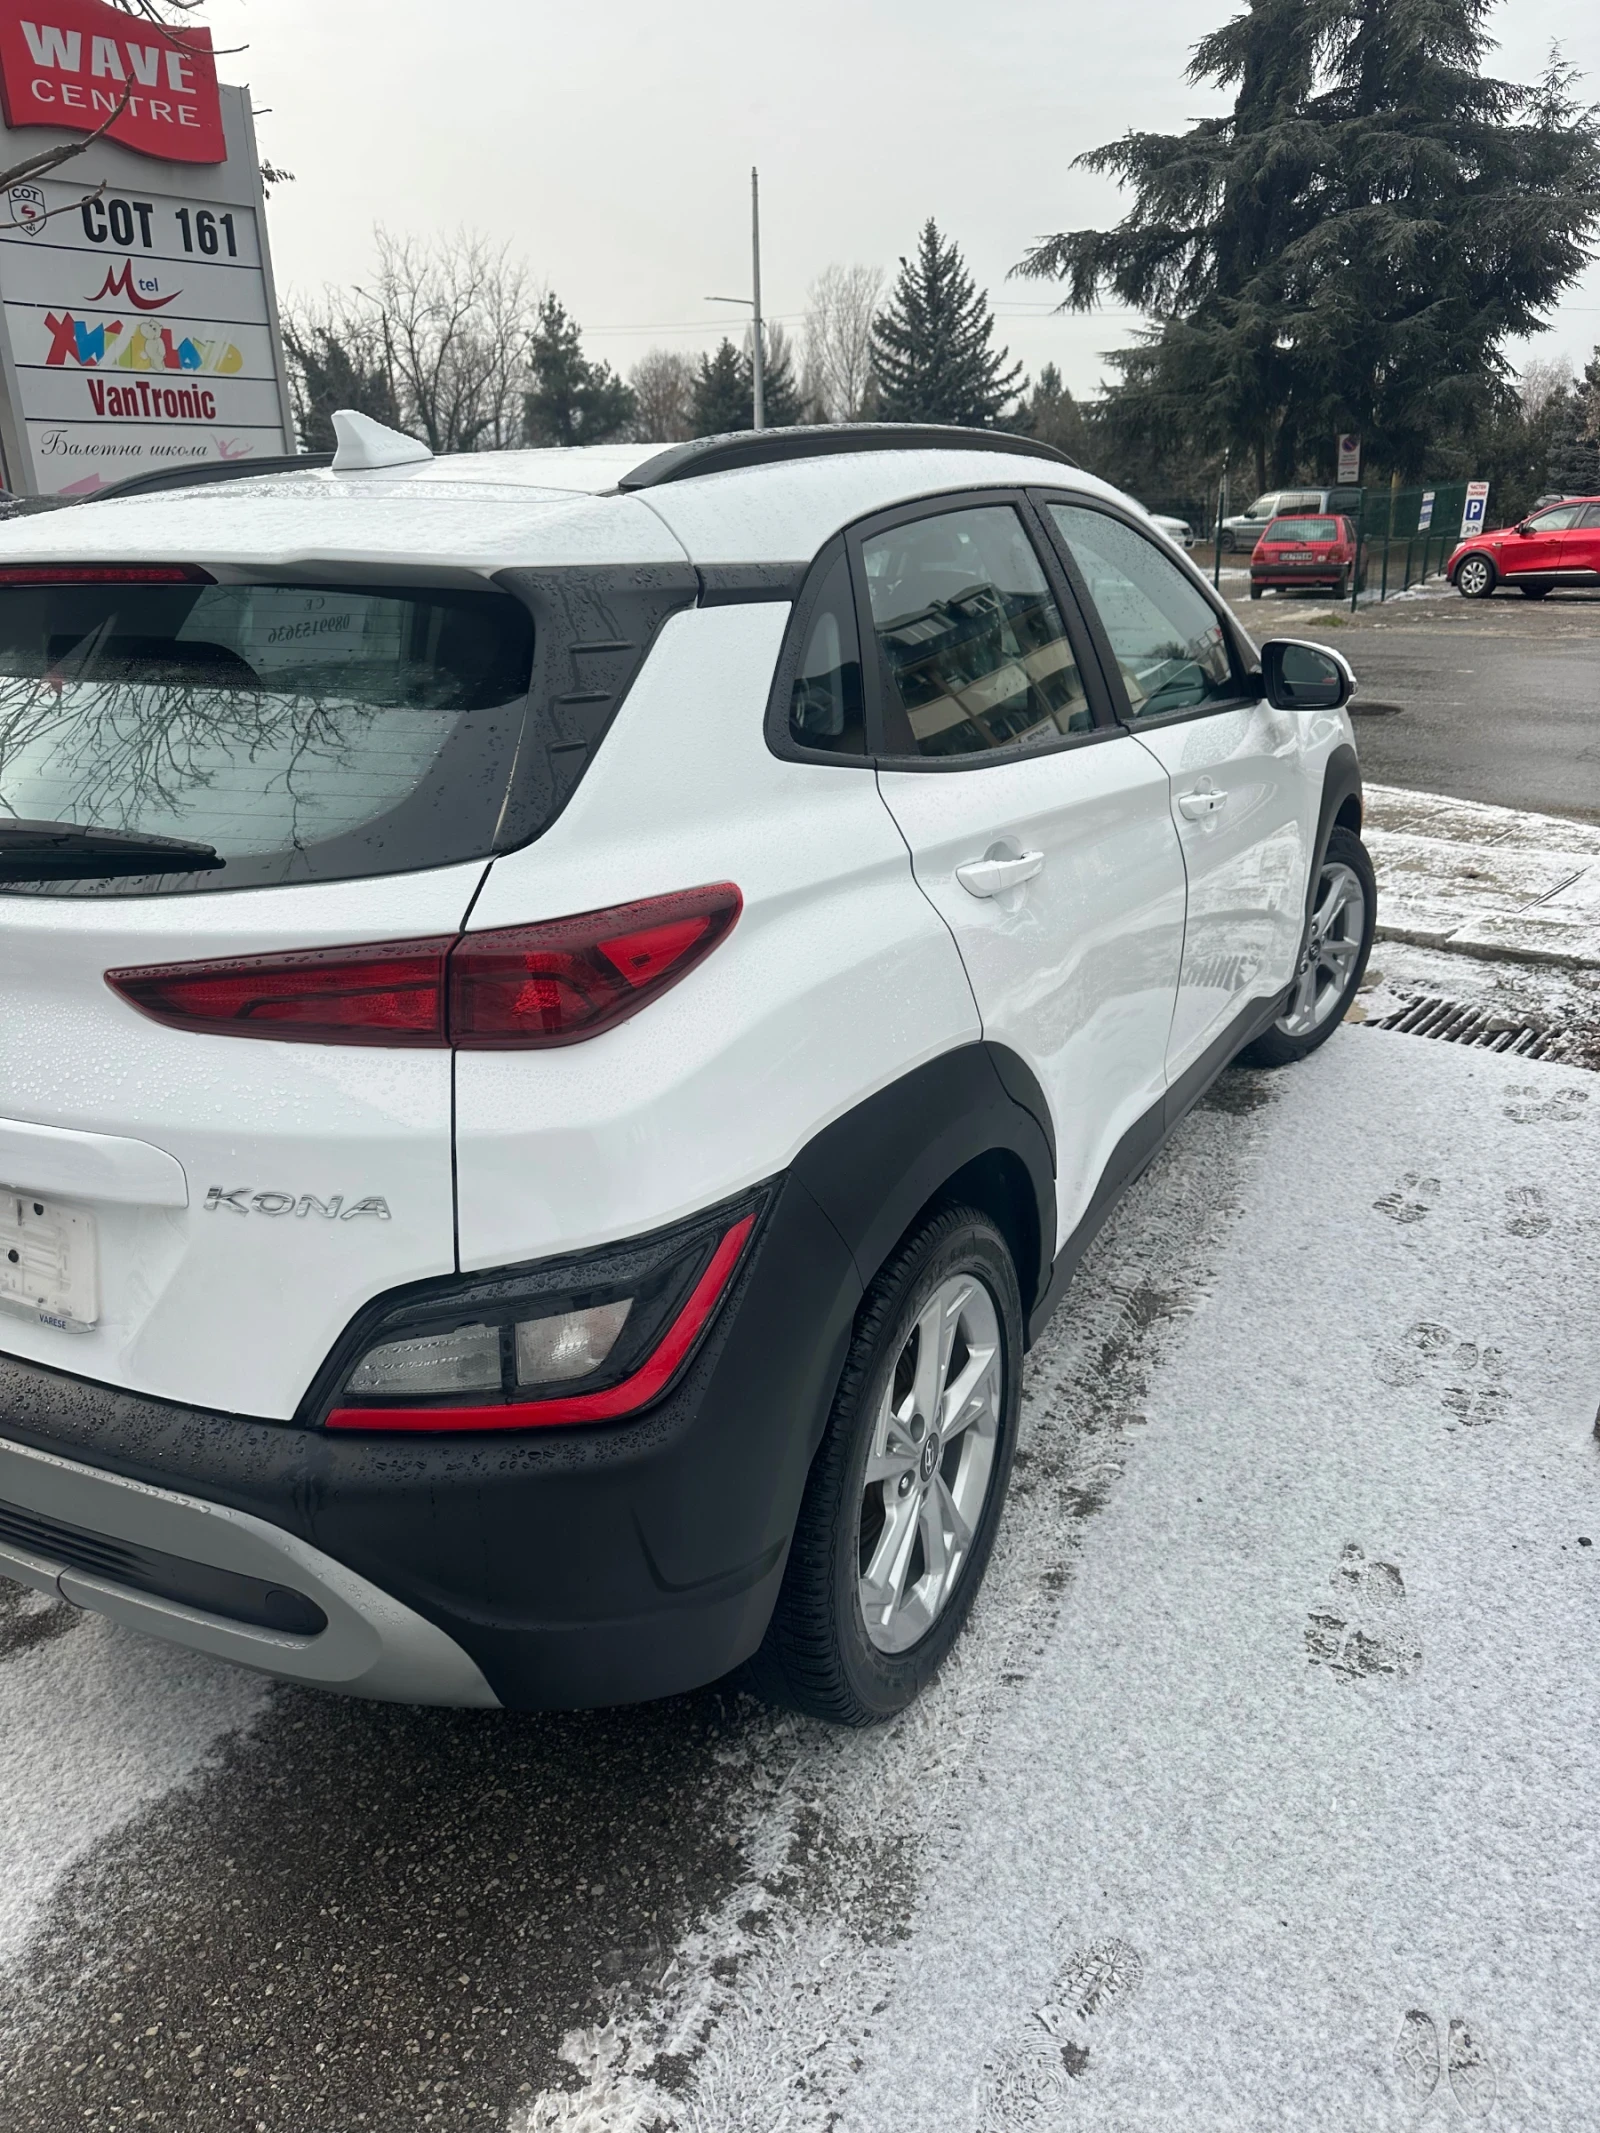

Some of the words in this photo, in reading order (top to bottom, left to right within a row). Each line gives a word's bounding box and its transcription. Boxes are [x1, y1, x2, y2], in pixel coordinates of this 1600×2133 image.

[20, 20, 197, 95] WAVE
[31, 79, 201, 128] CENTRE
[175, 207, 237, 257] 161
[87, 379, 216, 420] VanTronic
[40, 429, 144, 457] Балетна
[150, 442, 208, 457] школа
[203, 1185, 392, 1221] KONA
[39, 1313, 67, 1329] VARESE
